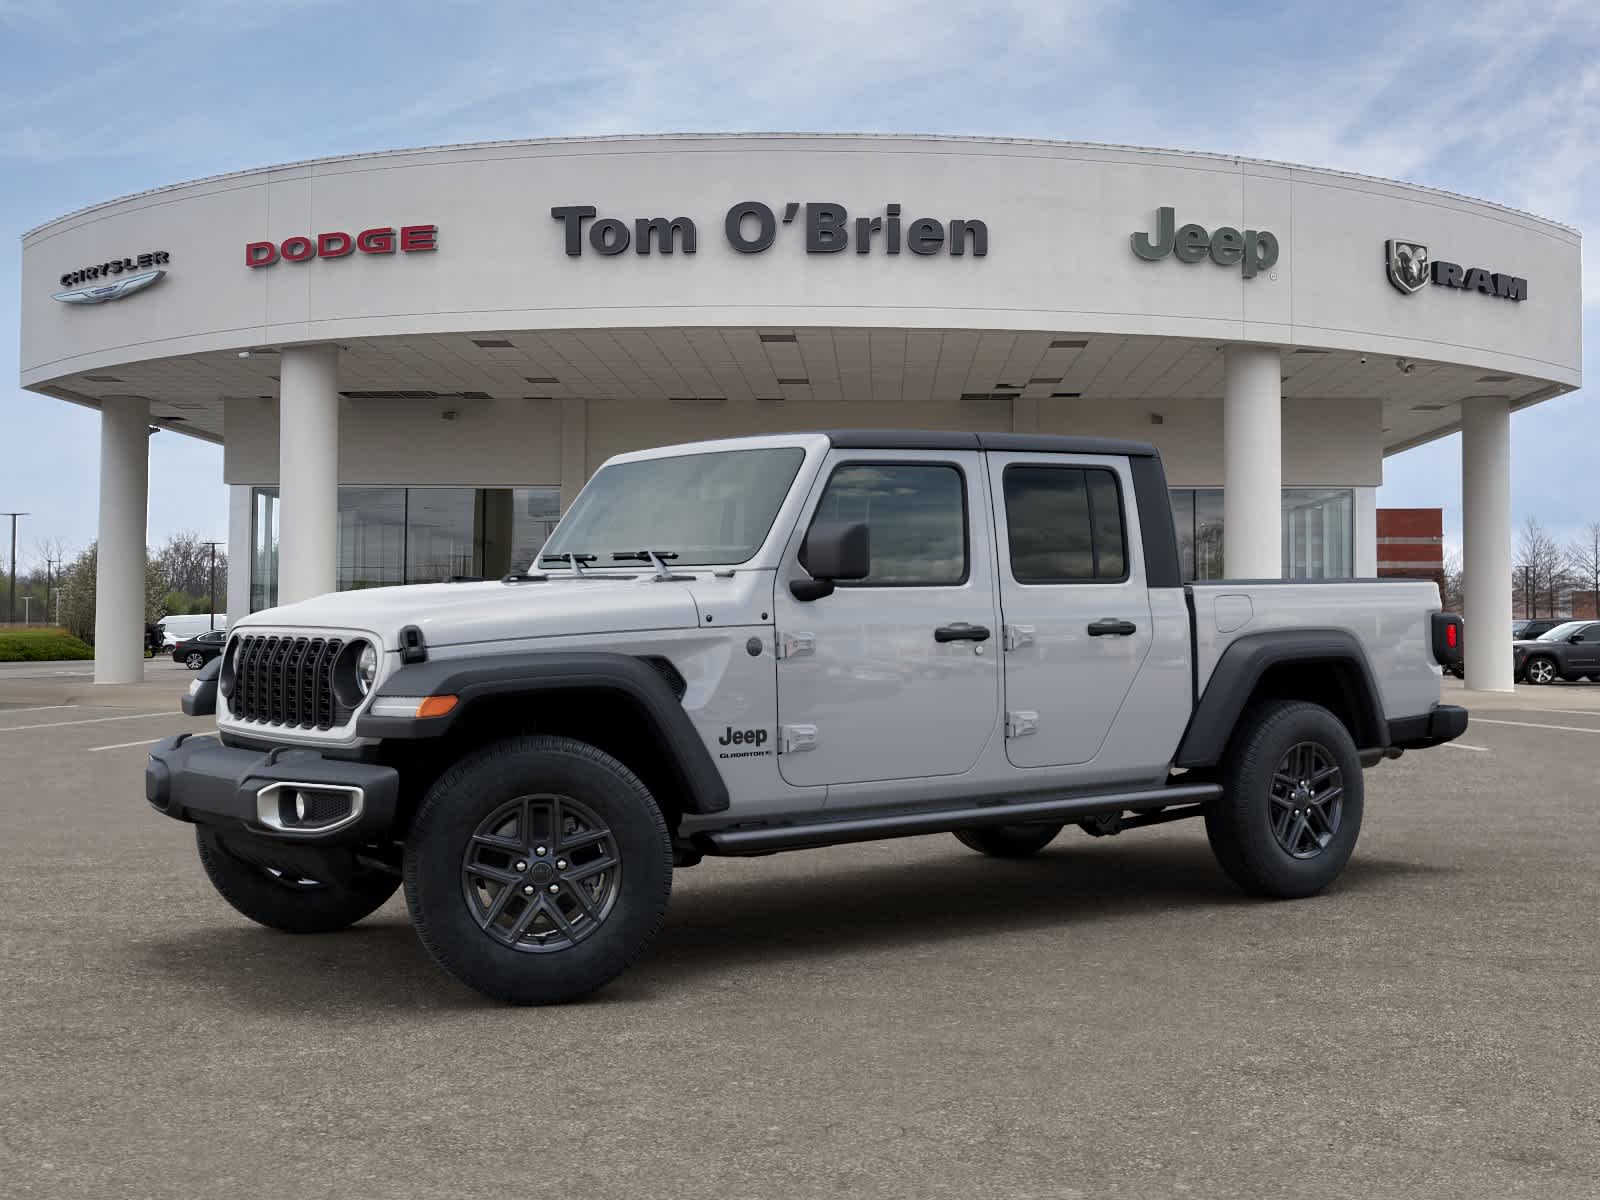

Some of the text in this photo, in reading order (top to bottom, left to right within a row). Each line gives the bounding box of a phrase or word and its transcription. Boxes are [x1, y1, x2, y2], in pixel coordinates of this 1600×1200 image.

[245, 224, 439, 270] DODGE
[551, 205, 697, 257] Tom
[1130, 206, 1280, 279] Jeep
[59, 249, 170, 288] CHRYSLER
[1430, 260, 1528, 302] RAM
[719, 726, 767, 747] Jeep
